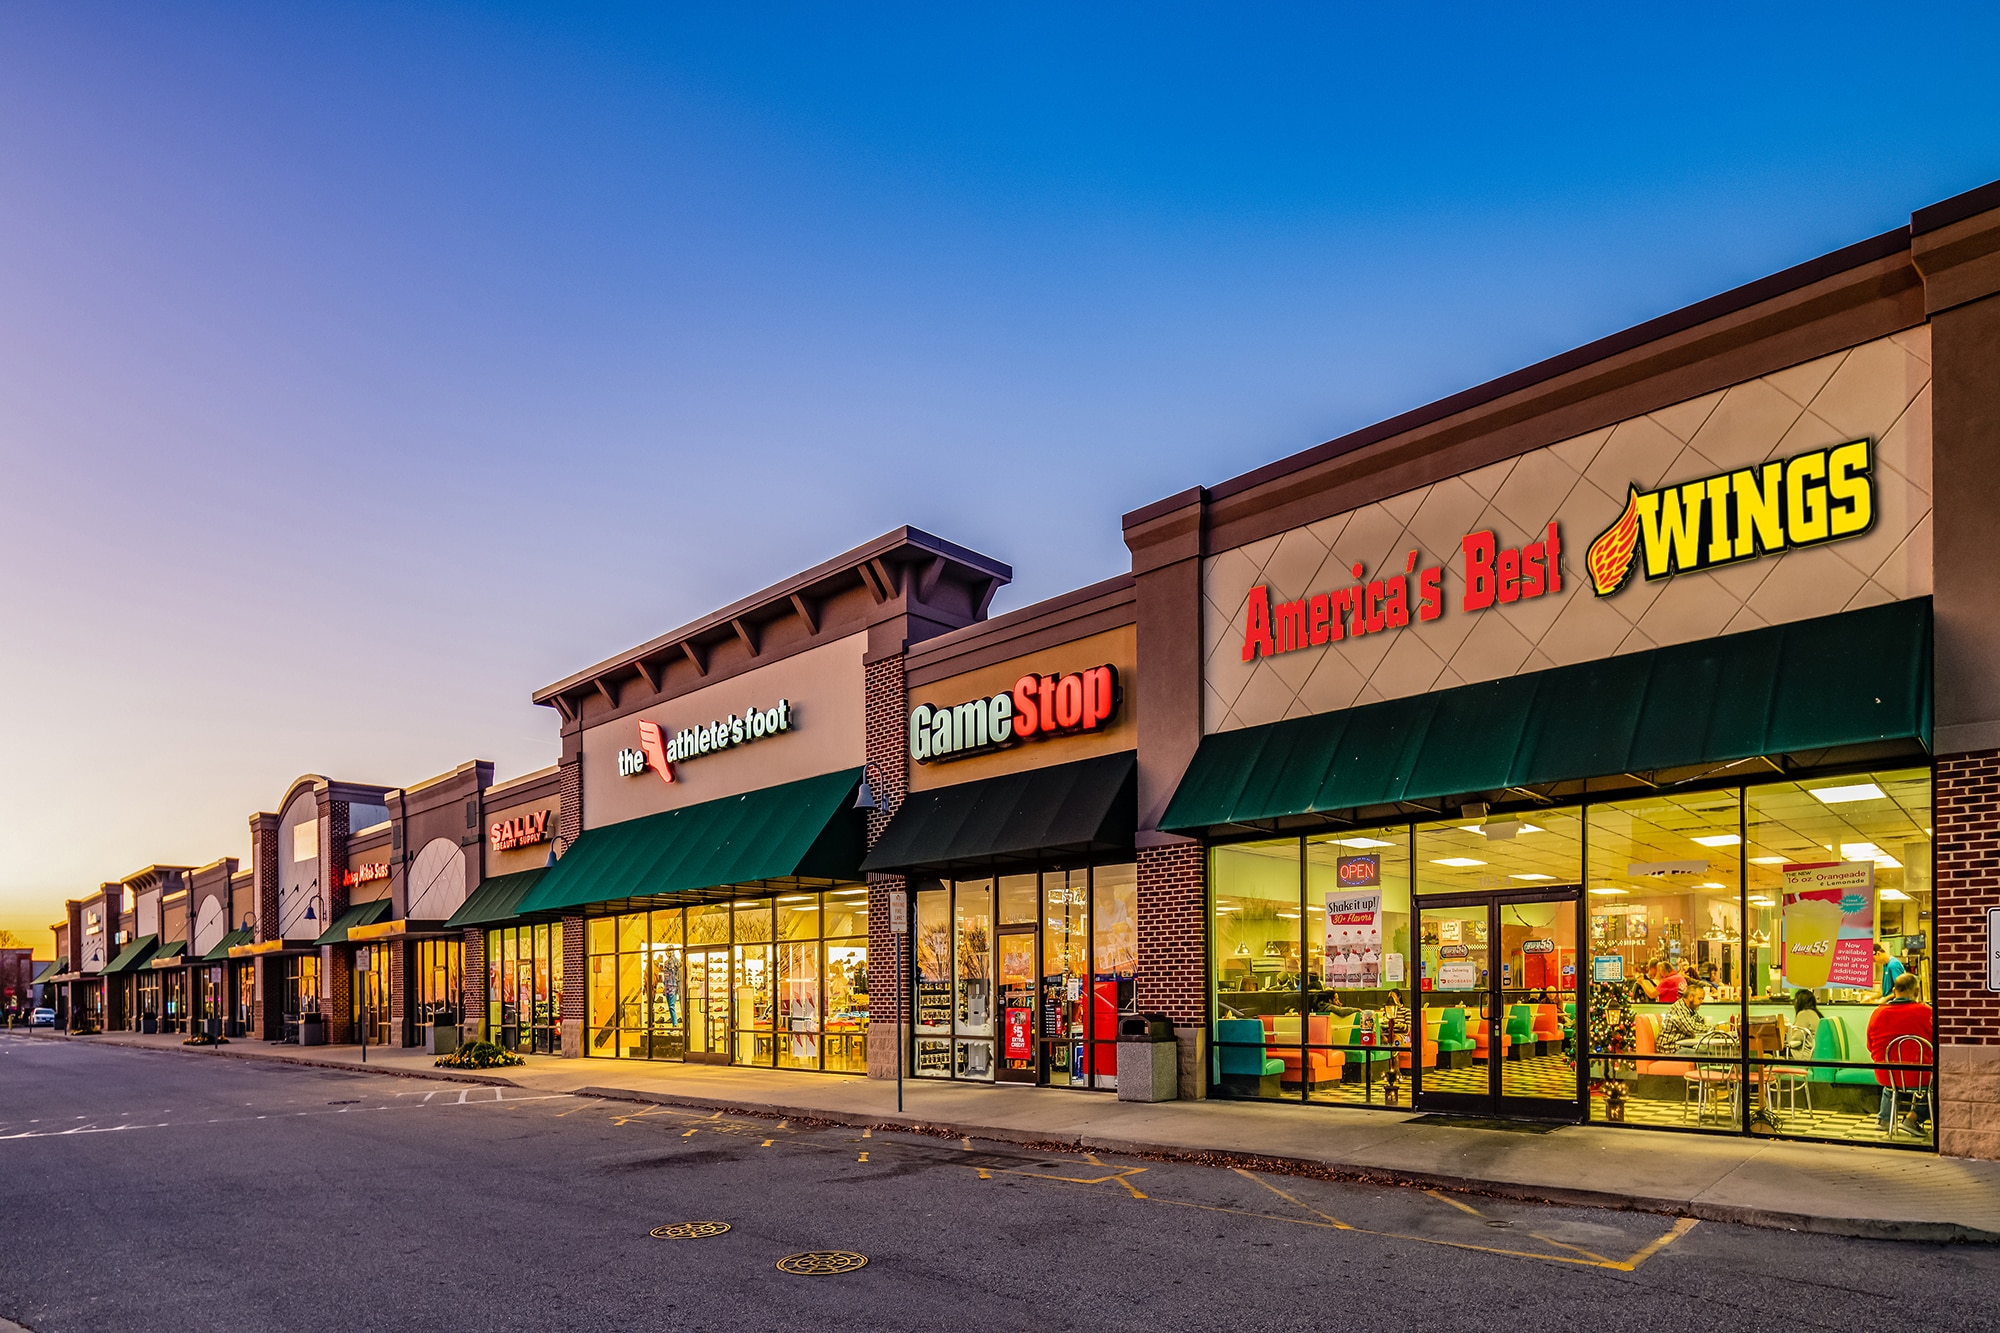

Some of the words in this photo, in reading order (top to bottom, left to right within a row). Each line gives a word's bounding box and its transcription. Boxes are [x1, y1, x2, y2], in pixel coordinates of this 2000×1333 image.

[1637, 440, 1871, 577] WINGS
[1242, 550, 1441, 662] America's
[1462, 521, 1561, 612] Best
[910, 665, 1113, 761] GameStop
[618, 748, 644, 777] the
[666, 713, 744, 764] athlete's
[745, 698, 788, 740] foot
[490, 809, 548, 844] SALLY
[519, 832, 541, 846] SUPPLY
[1340, 864, 1374, 879] OPEN
[1787, 876, 1799, 884] 16
[1816, 871, 1866, 881] Orangeade
[1328, 900, 1353, 914] Shake
[1354, 899, 1360, 910] it
[1362, 896, 1376, 911] up!
[1332, 914, 1346, 924] 30+
[1347, 912, 1372, 923] Flavors
[1540, 937, 1553, 950] 55
[1791, 943, 1813, 953] Hwy
[1812, 940, 1830, 953] 55
[1013, 1025, 1023, 1038] $5
